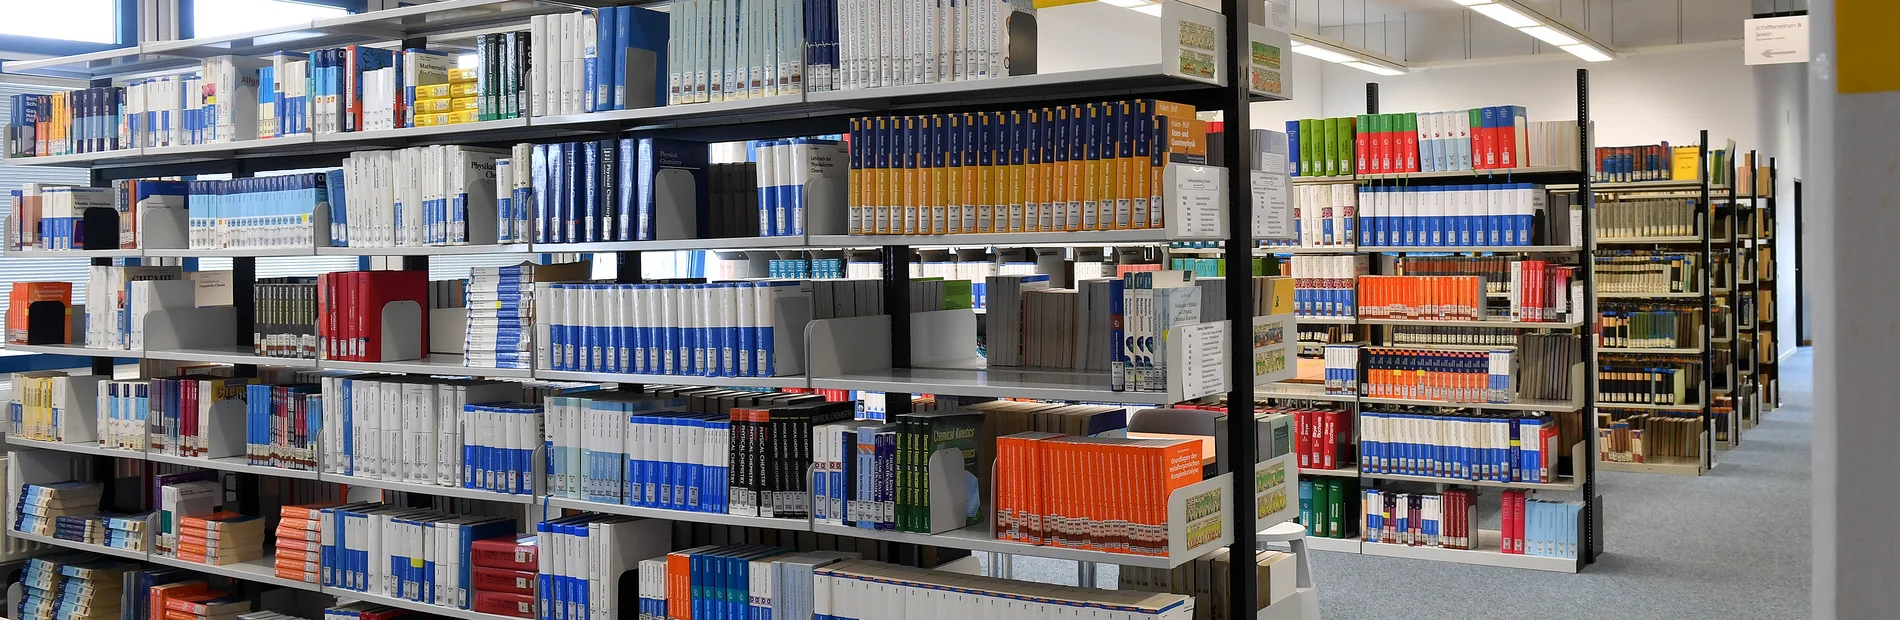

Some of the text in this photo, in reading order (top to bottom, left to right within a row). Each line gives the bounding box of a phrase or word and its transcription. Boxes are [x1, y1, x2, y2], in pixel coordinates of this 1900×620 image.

[419, 63, 447, 72] Mathematik
[240, 76, 259, 85] Allge
[660, 150, 677, 159] Physical
[471, 160, 496, 171] Physikal
[659, 158, 682, 166] Chemistry
[216, 385, 246, 398] Chem
[934, 427, 975, 442] Chemical Kinetics
[962, 448, 976, 458] amics
[1171, 455, 1190, 464] Grundlagen
[1169, 460, 1200, 473] metallorganischen
[1170, 468, 1199, 479] Komplexkatalyse
